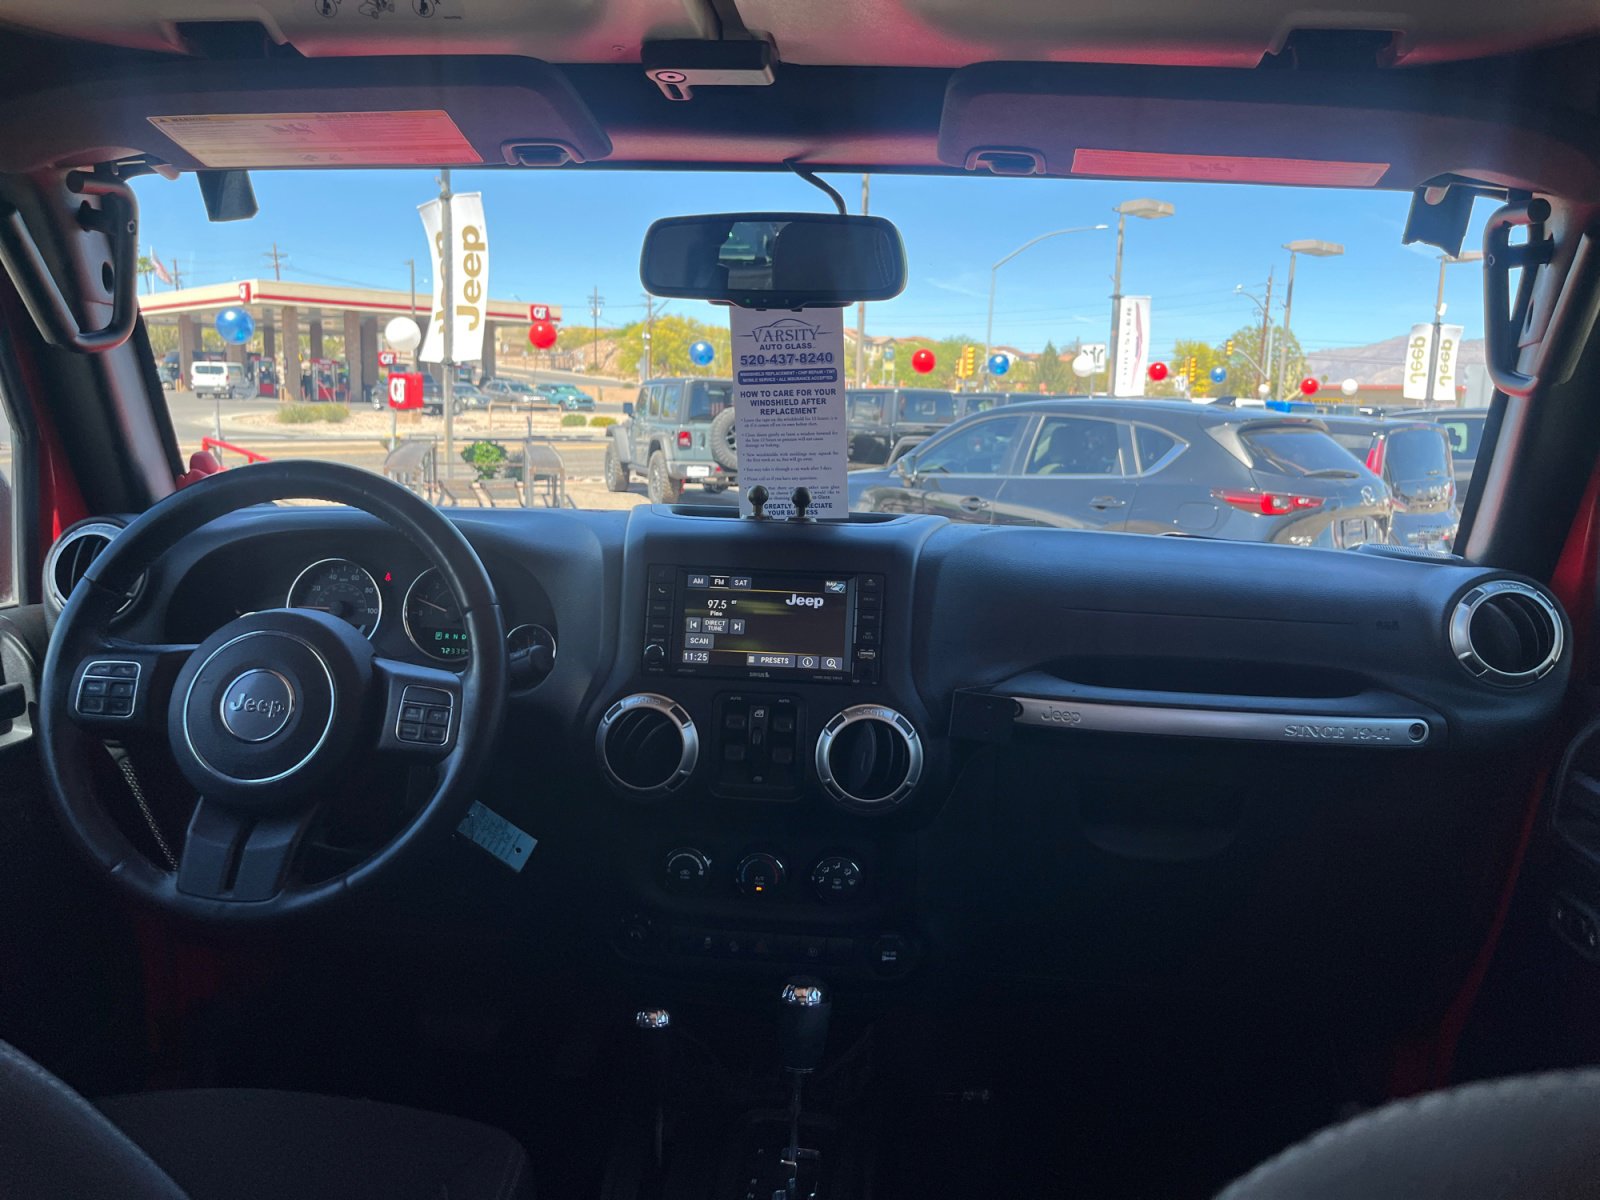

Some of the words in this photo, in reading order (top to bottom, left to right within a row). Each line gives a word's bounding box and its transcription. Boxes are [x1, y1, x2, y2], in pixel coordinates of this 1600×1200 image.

[456, 225, 486, 331] Jeep
[752, 325, 820, 343] VARSITY
[759, 343, 782, 351] AUTO
[785, 342, 812, 350] GLASS
[740, 352, 833, 366] 520-437-8240
[390, 377, 406, 404] QT
[740, 390, 759, 398] HOW
[773, 389, 794, 397] CARE
[814, 388, 837, 396] YOUR
[750, 399, 799, 407] WINDSHIELD
[760, 407, 817, 415] REPLACEMENT
[692, 577, 704, 585] AM
[707, 599, 727, 609] 97.5
[786, 594, 824, 608] Jeep
[690, 637, 709, 645] SCAN
[684, 652, 708, 662] 11:25
[230, 692, 281, 718] Jeep
[1041, 705, 1081, 726] Jeep
[1284, 725, 1345, 739] SINCE
